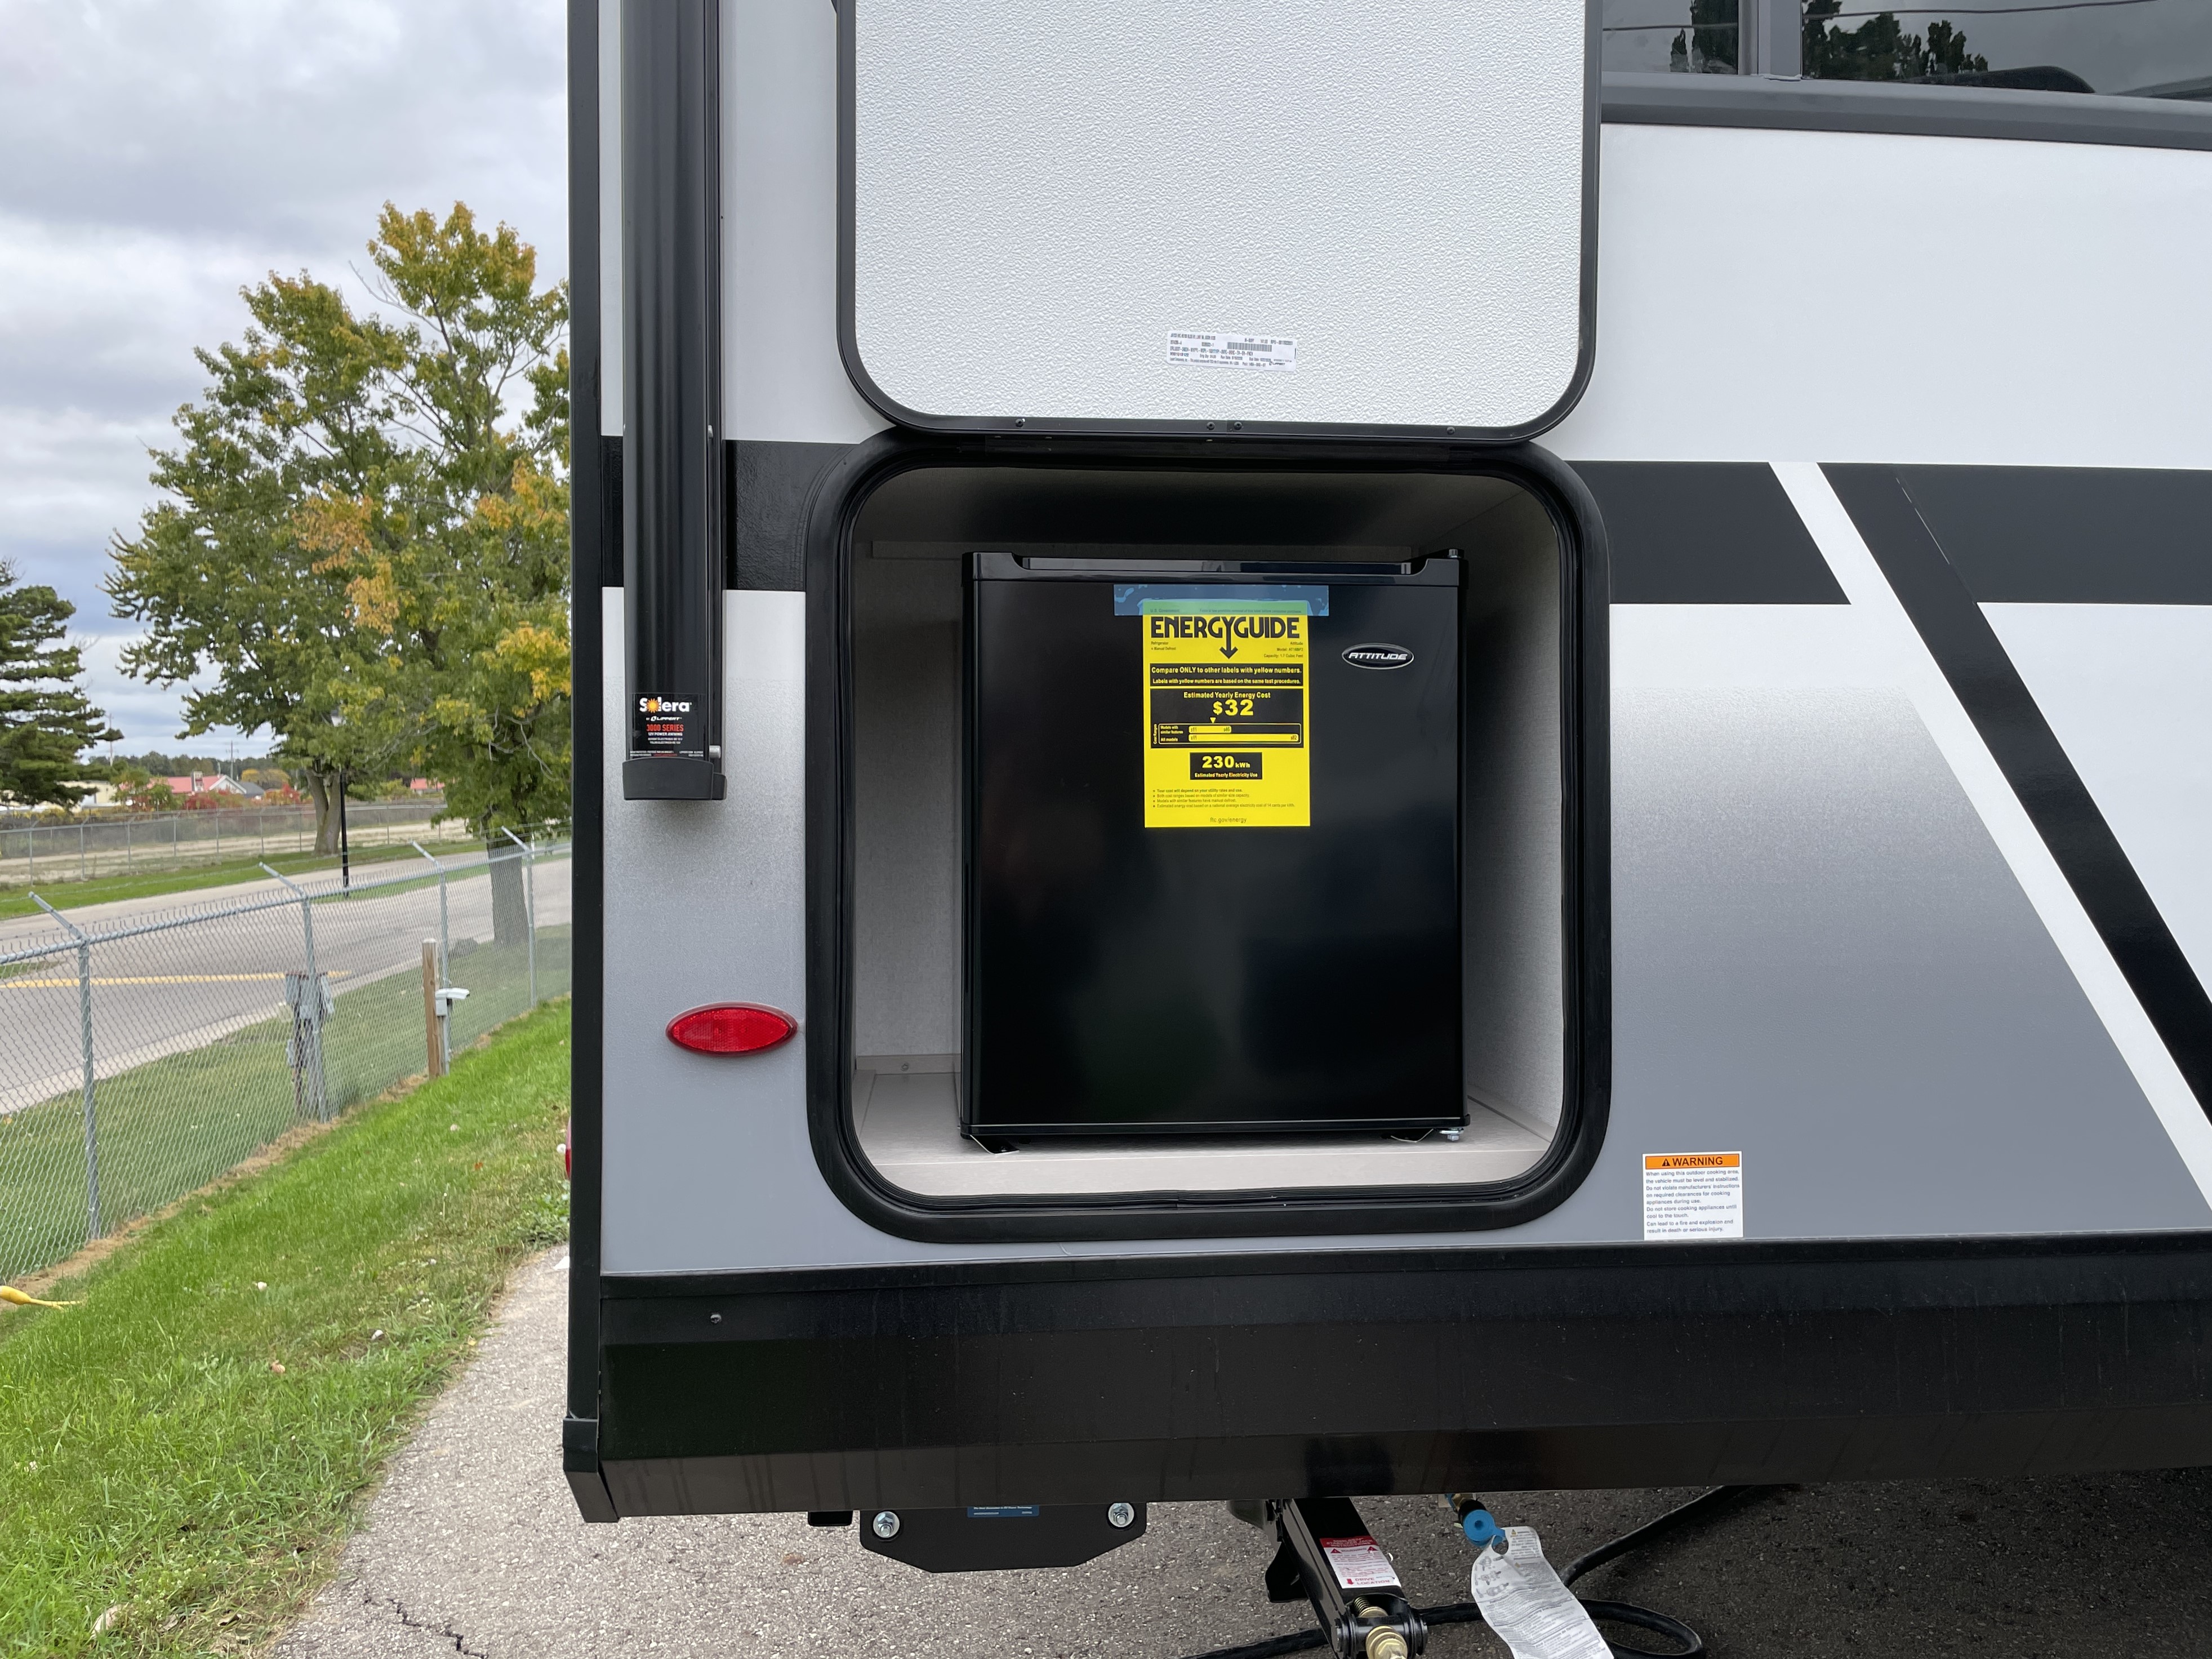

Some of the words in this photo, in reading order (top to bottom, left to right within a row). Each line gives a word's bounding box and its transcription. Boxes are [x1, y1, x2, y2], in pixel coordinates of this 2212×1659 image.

[1151, 616, 1299, 639] ENERGYGUIDE
[639, 697, 690, 713] Solera
[1213, 699, 1254, 716] $32
[1202, 755, 1235, 768] 230
[1672, 1157, 1723, 1166] WARNING
